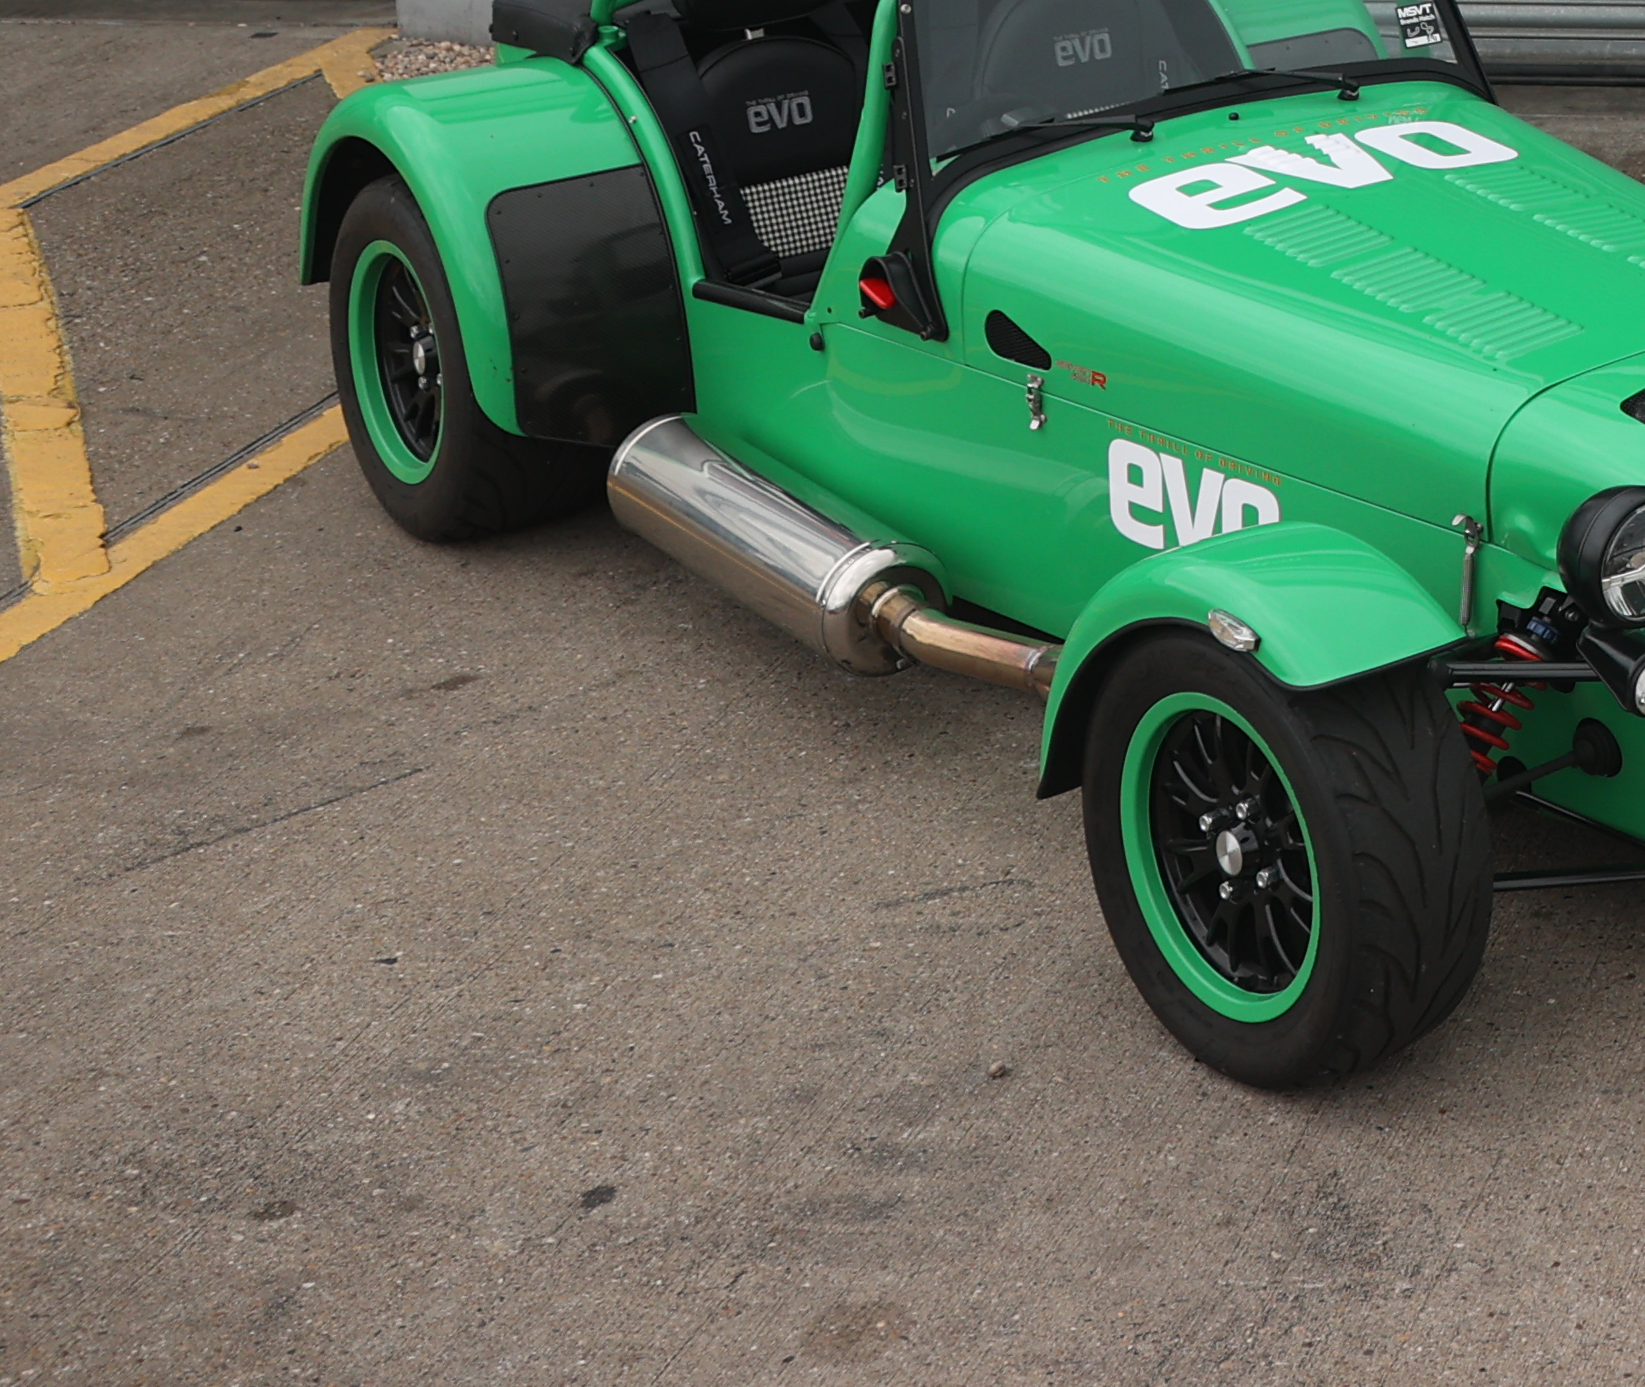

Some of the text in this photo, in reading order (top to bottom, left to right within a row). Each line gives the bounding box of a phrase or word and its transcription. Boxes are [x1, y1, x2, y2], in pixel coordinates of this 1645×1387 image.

[1397, 3, 1432, 18] MSVT
[1053, 32, 1112, 67] evo
[745, 96, 814, 134] evo
[688, 131, 733, 225] CATERHAM
[1128, 121, 1519, 230] evo
[1107, 419, 1133, 435] THE
[1139, 430, 1189, 455] THRILL
[1218, 457, 1282, 486] DRIVING
